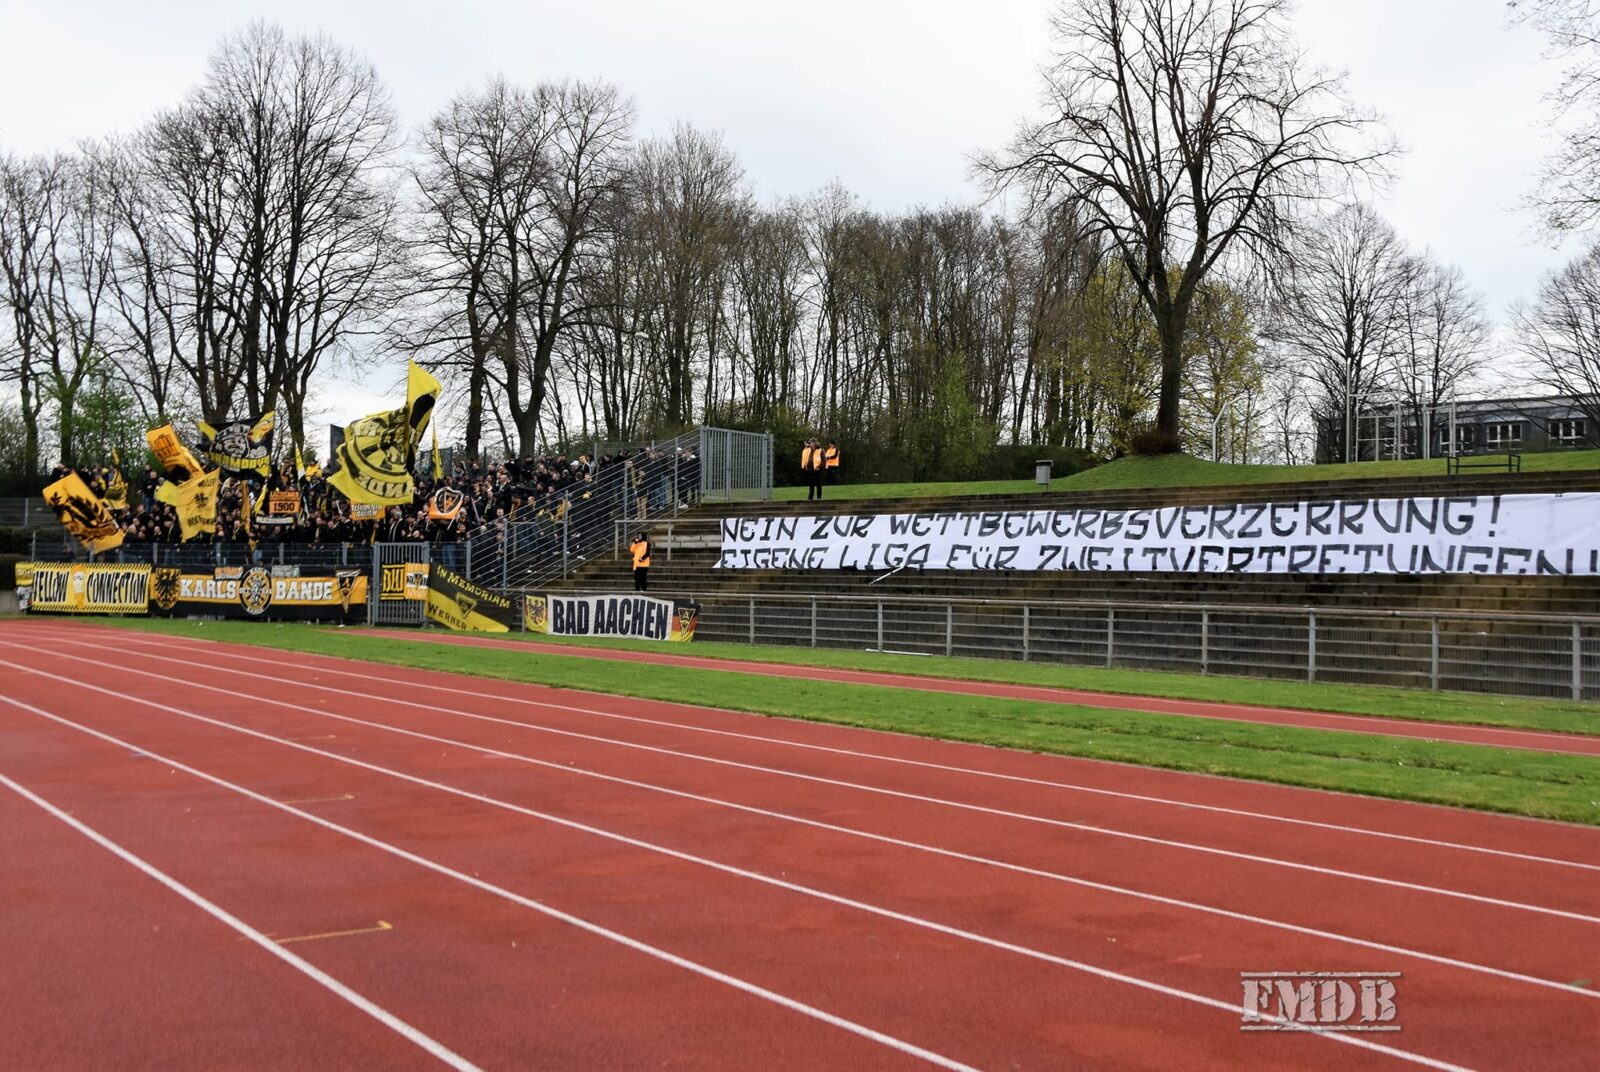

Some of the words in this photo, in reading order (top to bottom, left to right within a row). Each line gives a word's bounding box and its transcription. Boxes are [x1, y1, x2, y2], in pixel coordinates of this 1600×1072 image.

[273, 503, 295, 511] 1900
[722, 517, 800, 543] NEIN
[810, 515, 876, 540] ZUR
[890, 496, 1501, 539] WETTBEWERBSVERZERRUNG!
[721, 547, 829, 568] EIGENE
[839, 544, 931, 570] LIGA
[946, 544, 1020, 569] FÜR
[86, 571, 148, 604] CONNECTION
[180, 579, 236, 599] KARLS
[275, 580, 333, 600] BANDE
[436, 564, 447, 578] IN
[447, 571, 511, 609] MEMORIAM
[428, 602, 467, 631] WERNER
[553, 599, 590, 635] BAD
[593, 598, 669, 640] AACHEN
